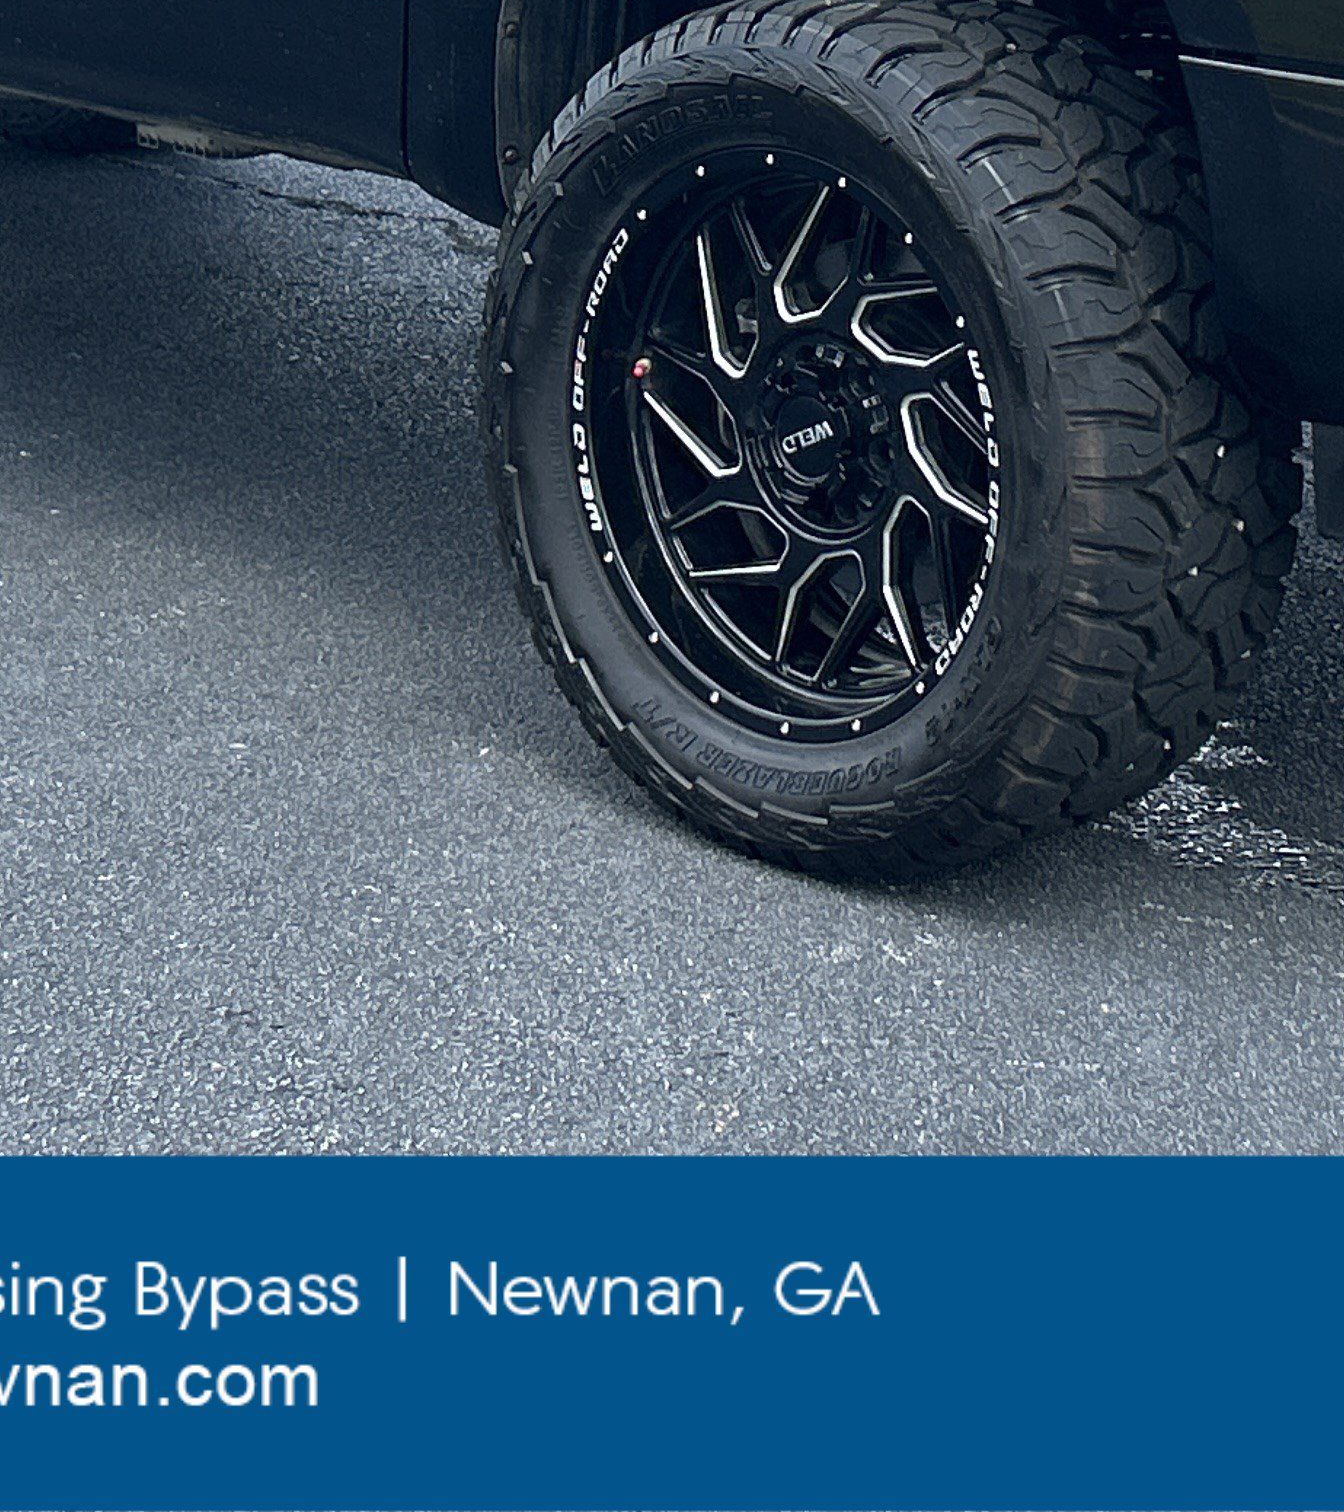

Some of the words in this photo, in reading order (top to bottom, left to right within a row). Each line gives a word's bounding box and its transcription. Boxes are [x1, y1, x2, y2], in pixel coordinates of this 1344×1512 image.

[572, 227, 630, 412] OFF-ROAD
[782, 420, 835, 454] WELD
[966, 348, 1001, 468] WELD
[571, 422, 604, 531] WELD
[934, 479, 1001, 676] OFF-ROAD
